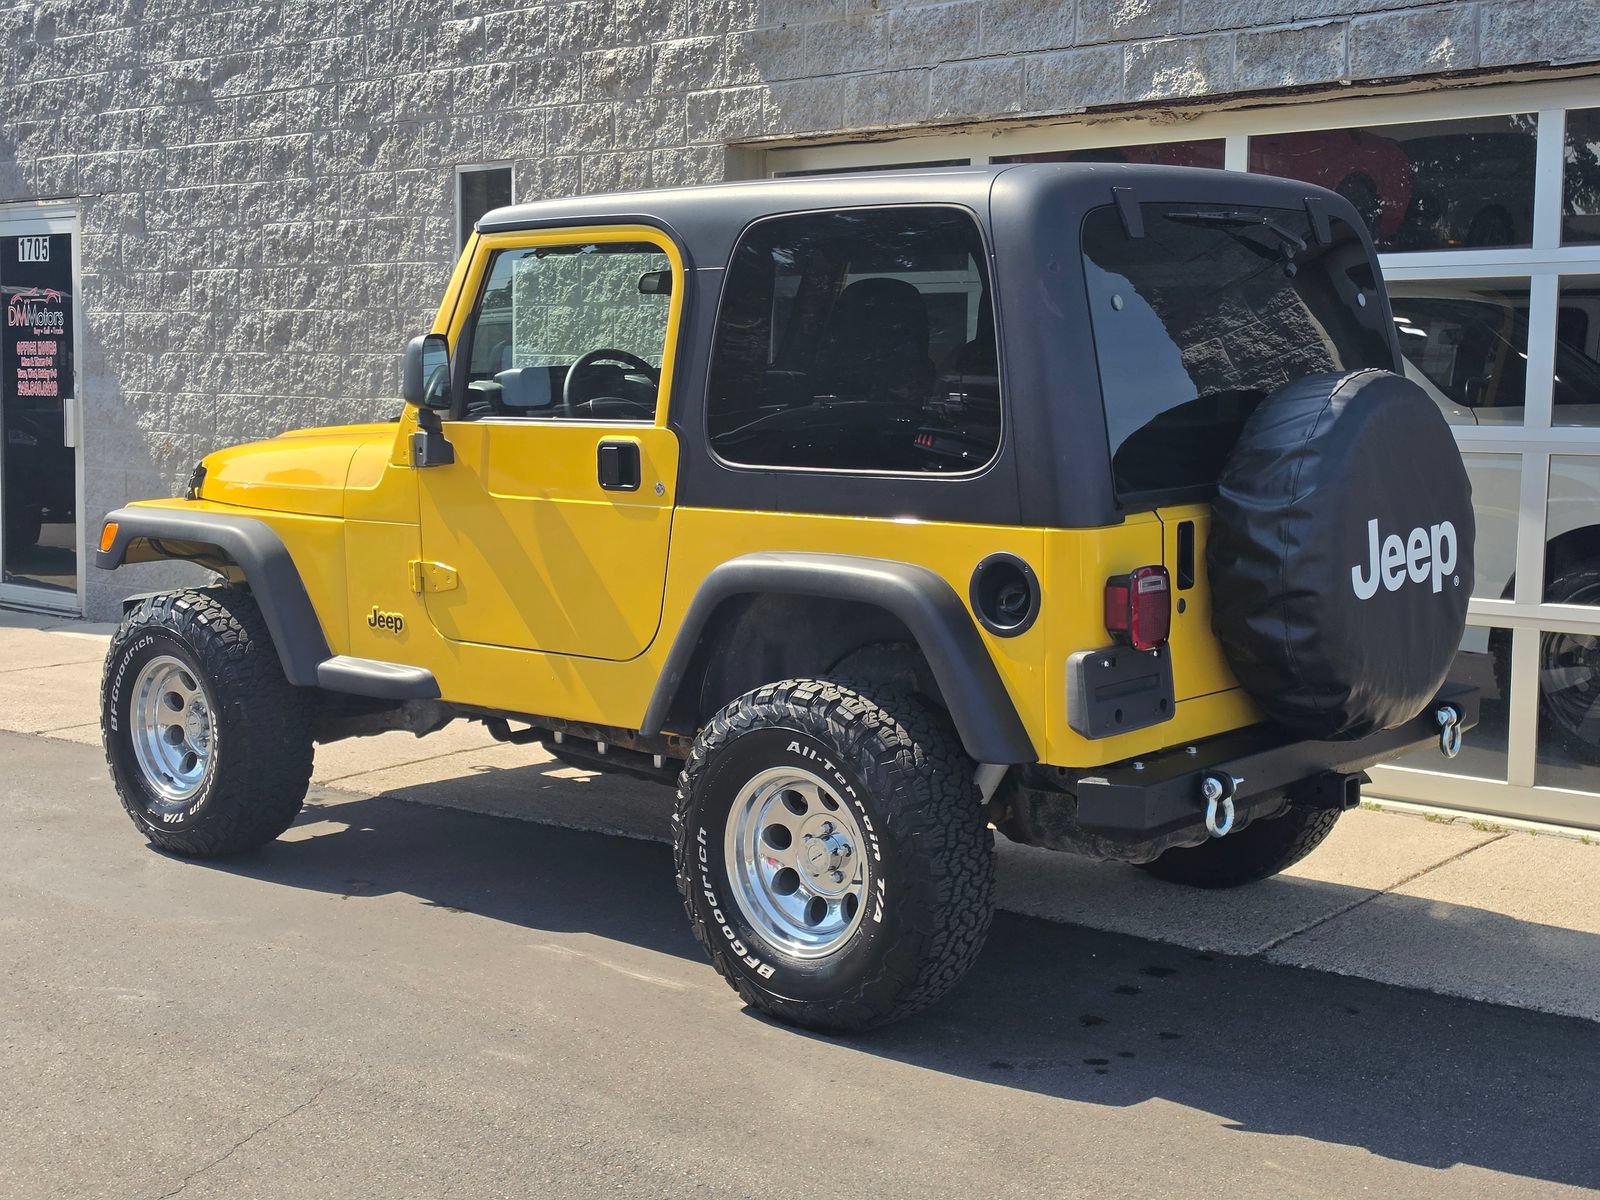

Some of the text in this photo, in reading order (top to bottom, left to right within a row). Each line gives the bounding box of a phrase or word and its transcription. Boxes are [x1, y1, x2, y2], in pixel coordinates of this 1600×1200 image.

[20, 238, 48, 260] 1705
[16, 341, 37, 356] OFFICE
[1351, 518, 1458, 600] Jeep
[367, 605, 404, 636] Jeep
[110, 634, 154, 732] BFGoodrich
[163, 812, 185, 824] T/A
[786, 740, 886, 924] All-Terrain T/A
[697, 825, 776, 980] BFGoodrich
